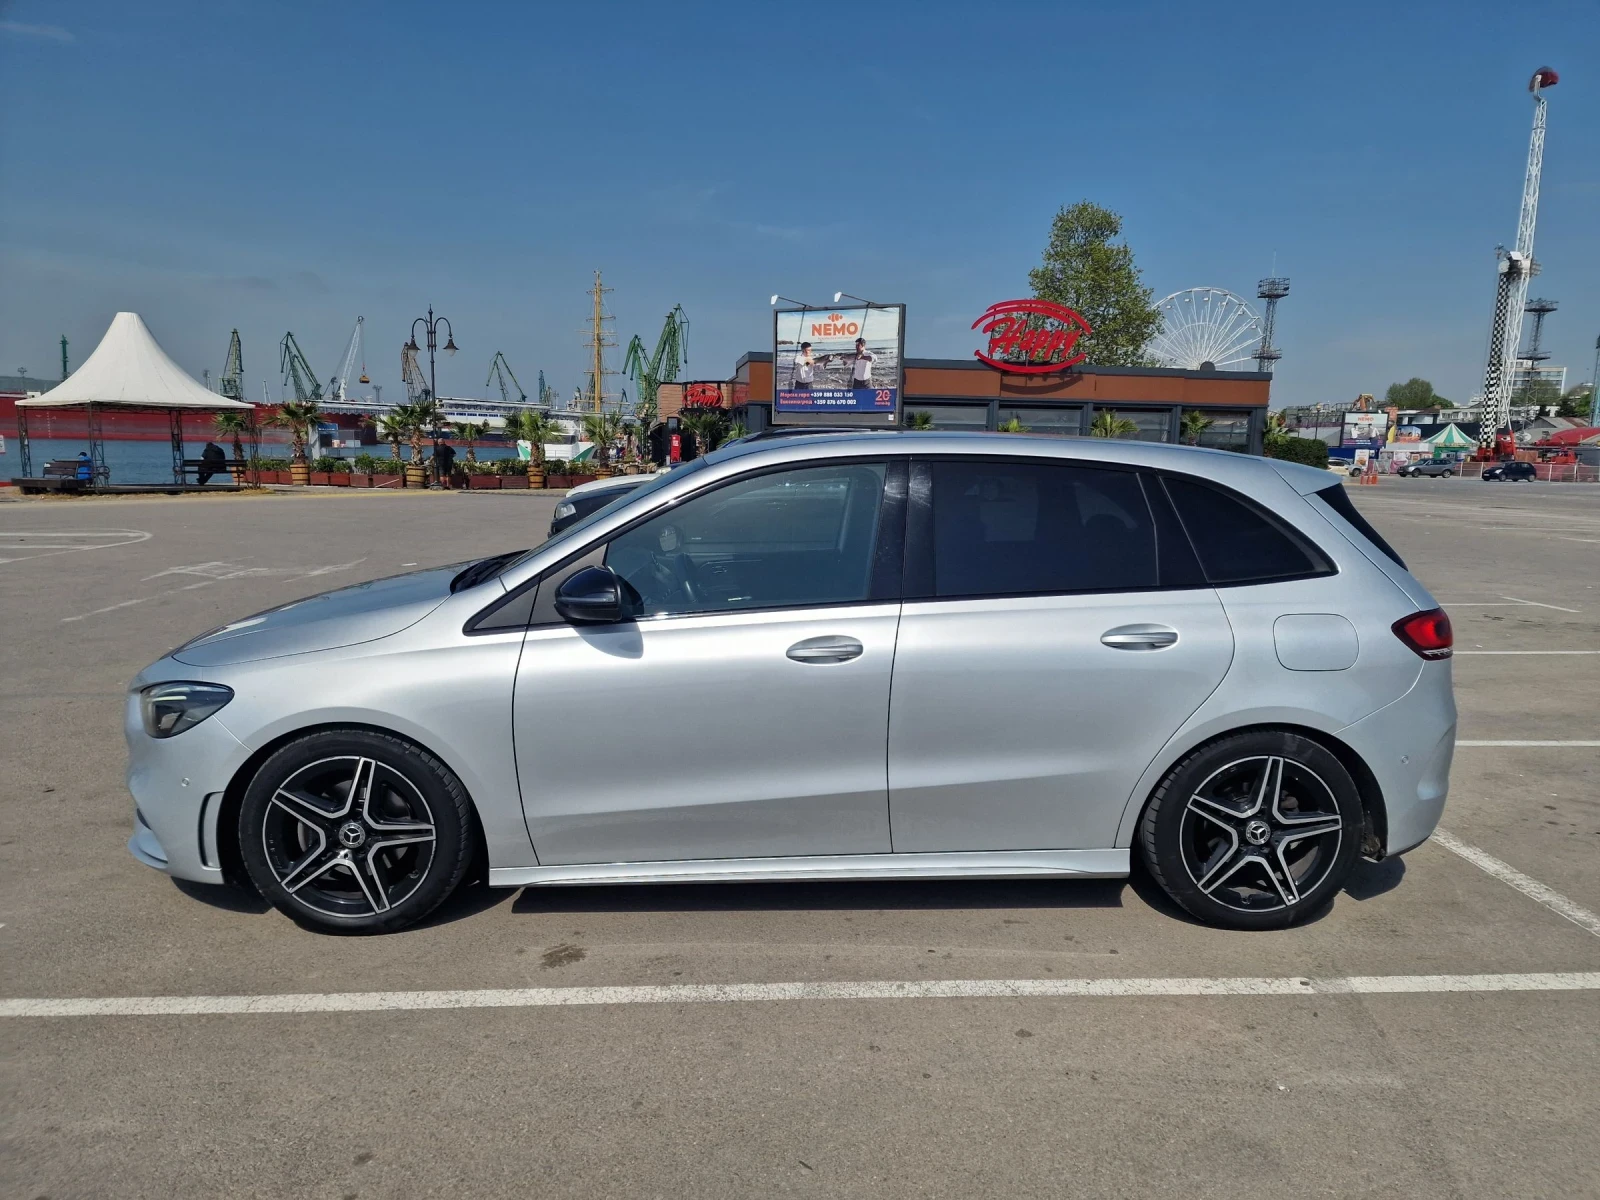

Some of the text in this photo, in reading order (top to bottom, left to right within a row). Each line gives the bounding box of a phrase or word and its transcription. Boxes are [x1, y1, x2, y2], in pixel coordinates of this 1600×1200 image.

[811, 322, 859, 337] NEMO
[982, 316, 1082, 360] Happy
[686, 388, 719, 407] Happy
